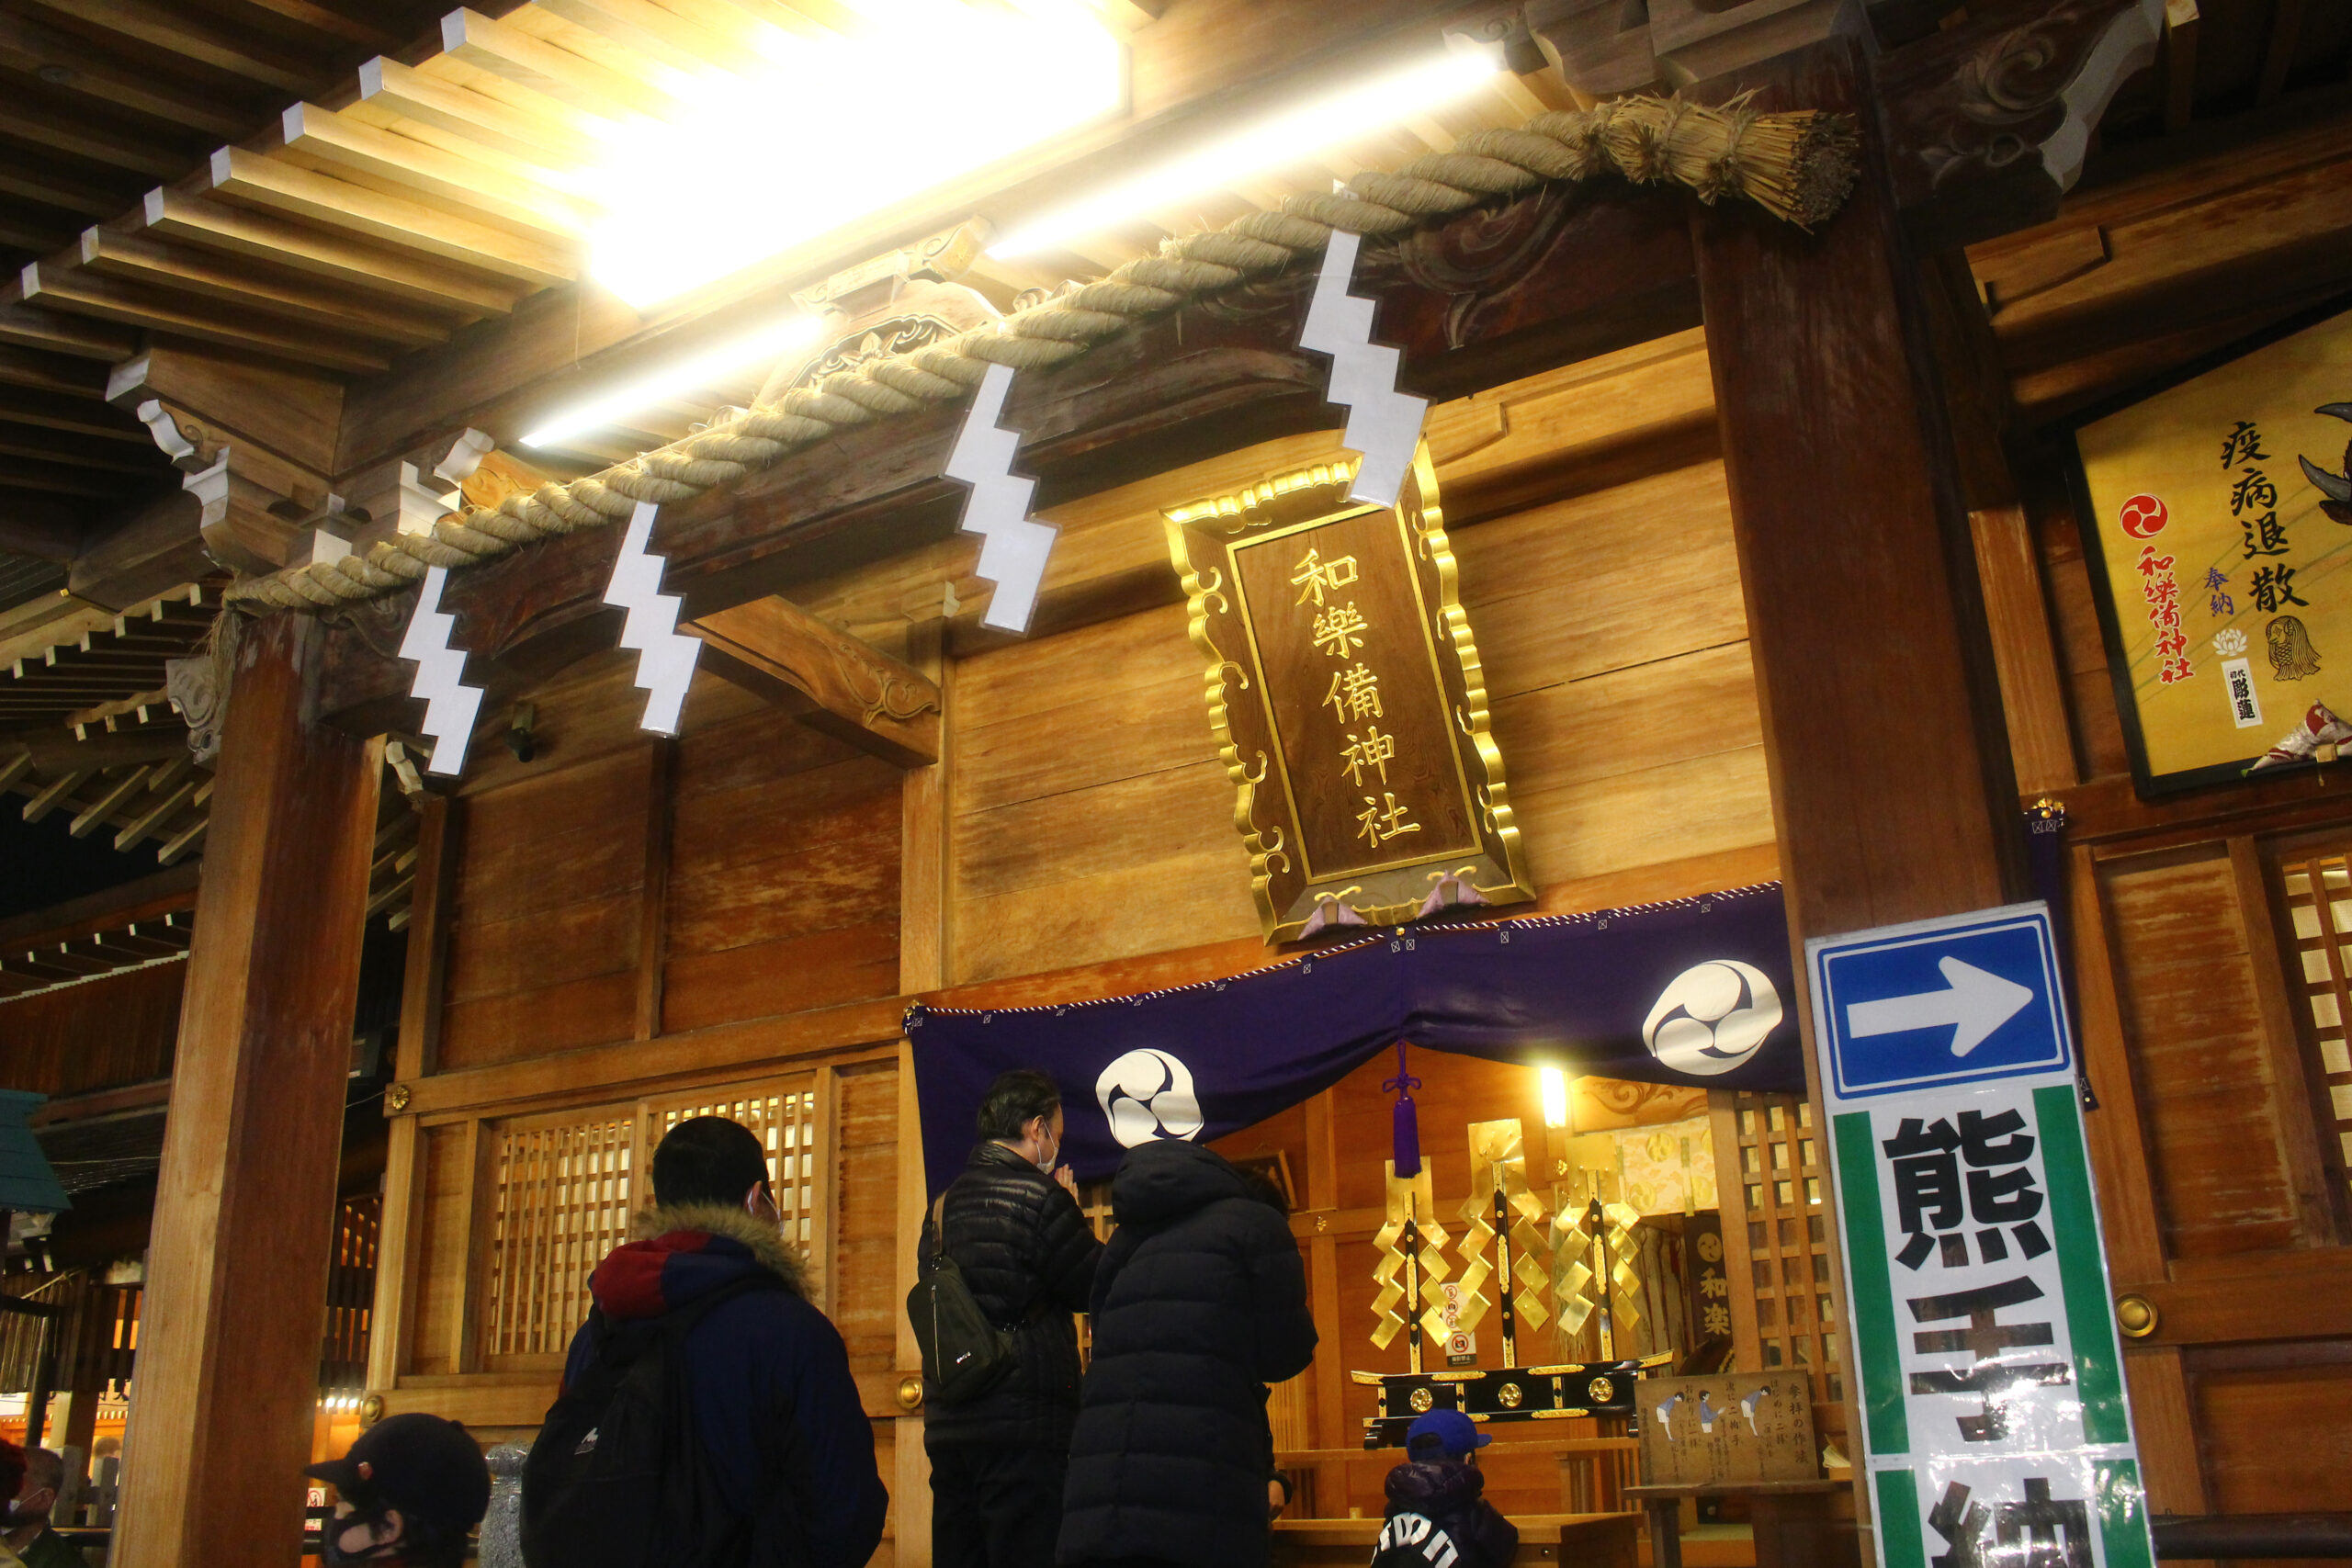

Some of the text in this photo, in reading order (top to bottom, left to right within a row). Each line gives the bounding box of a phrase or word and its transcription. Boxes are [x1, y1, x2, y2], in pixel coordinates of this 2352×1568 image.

[2204, 567, 2234, 616] 奉納
[2220, 422, 2309, 614] 疫病退散
[1290, 547, 1420, 848] 和樂備神社
